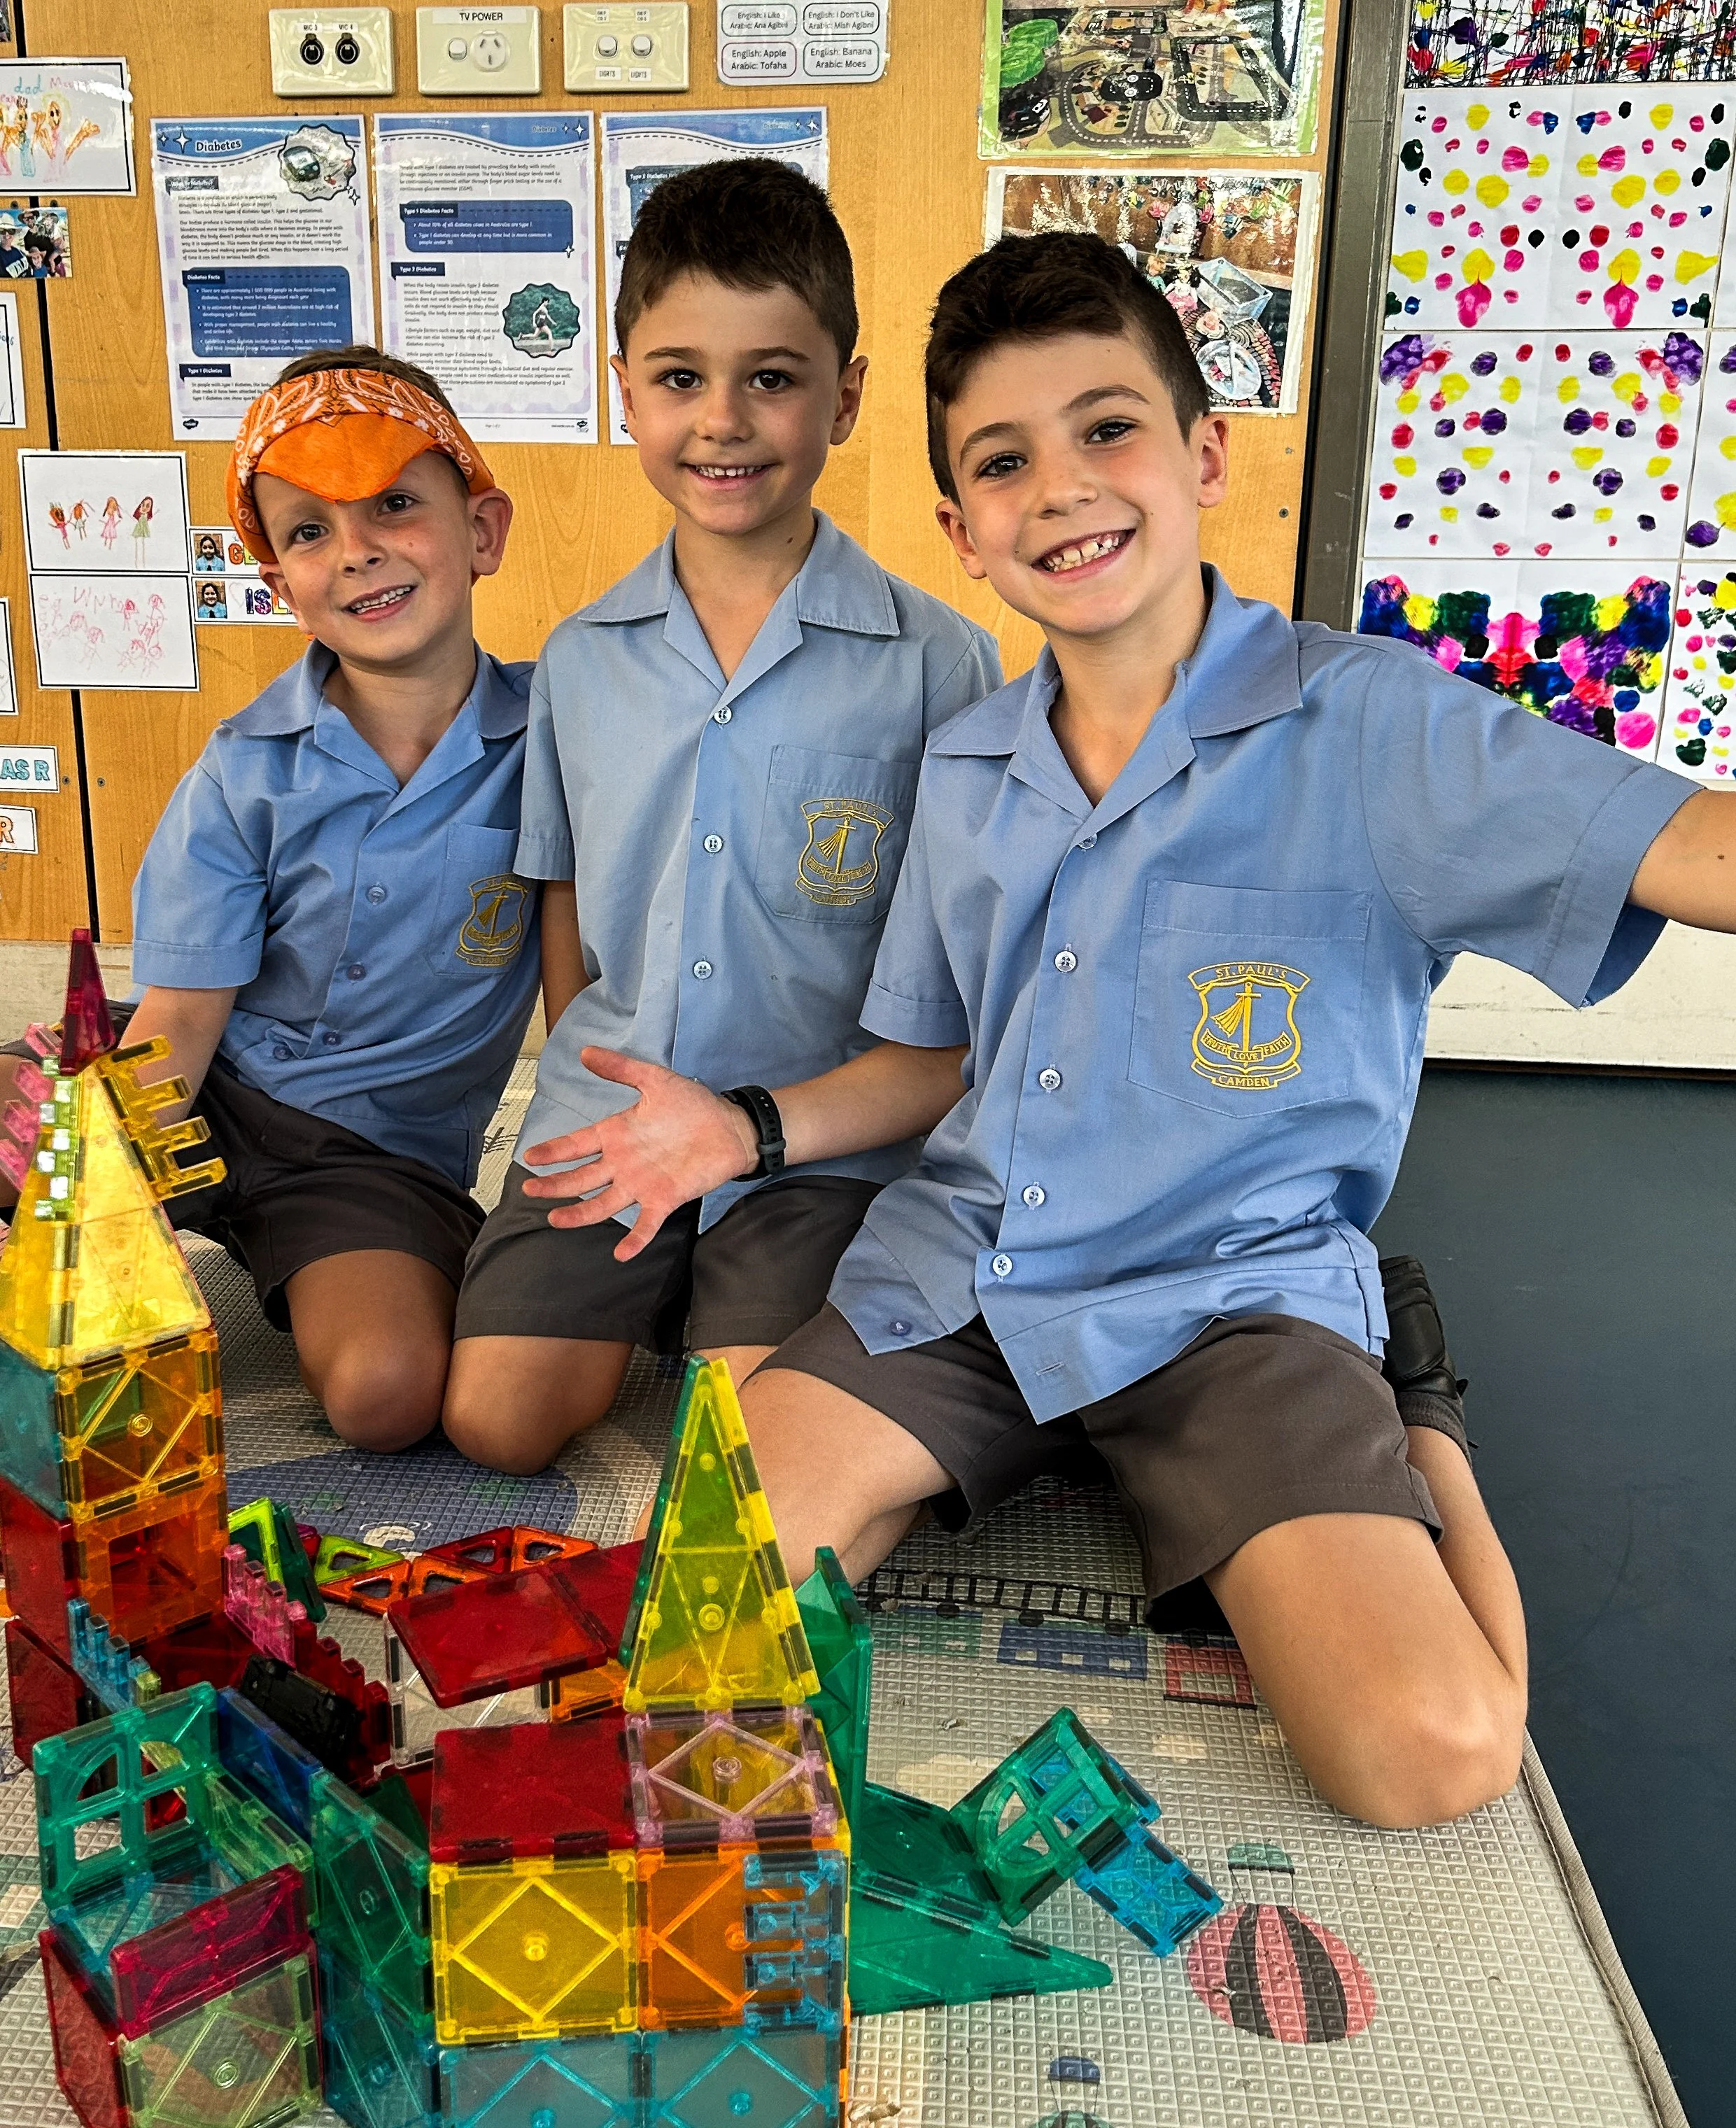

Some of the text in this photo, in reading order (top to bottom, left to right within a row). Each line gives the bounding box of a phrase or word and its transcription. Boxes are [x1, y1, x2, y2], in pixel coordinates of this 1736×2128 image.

[459, 12, 503, 21] TV POWER
[808, 11, 834, 20] English:
[732, 49, 786, 59] English: Apple
[810, 48, 840, 57] English:
[731, 62, 758, 70] Arabic:
[816, 60, 842, 69] Arabic:
[14, 73, 43, 94] dad
[196, 140, 241, 151] Diabetes
[245, 587, 293, 615] ISL
[1203, 1034, 1229, 1054] TRUTH
[1264, 1034, 1291, 1055] FAITH
[1218, 1076, 1270, 1087] CAMDEN
